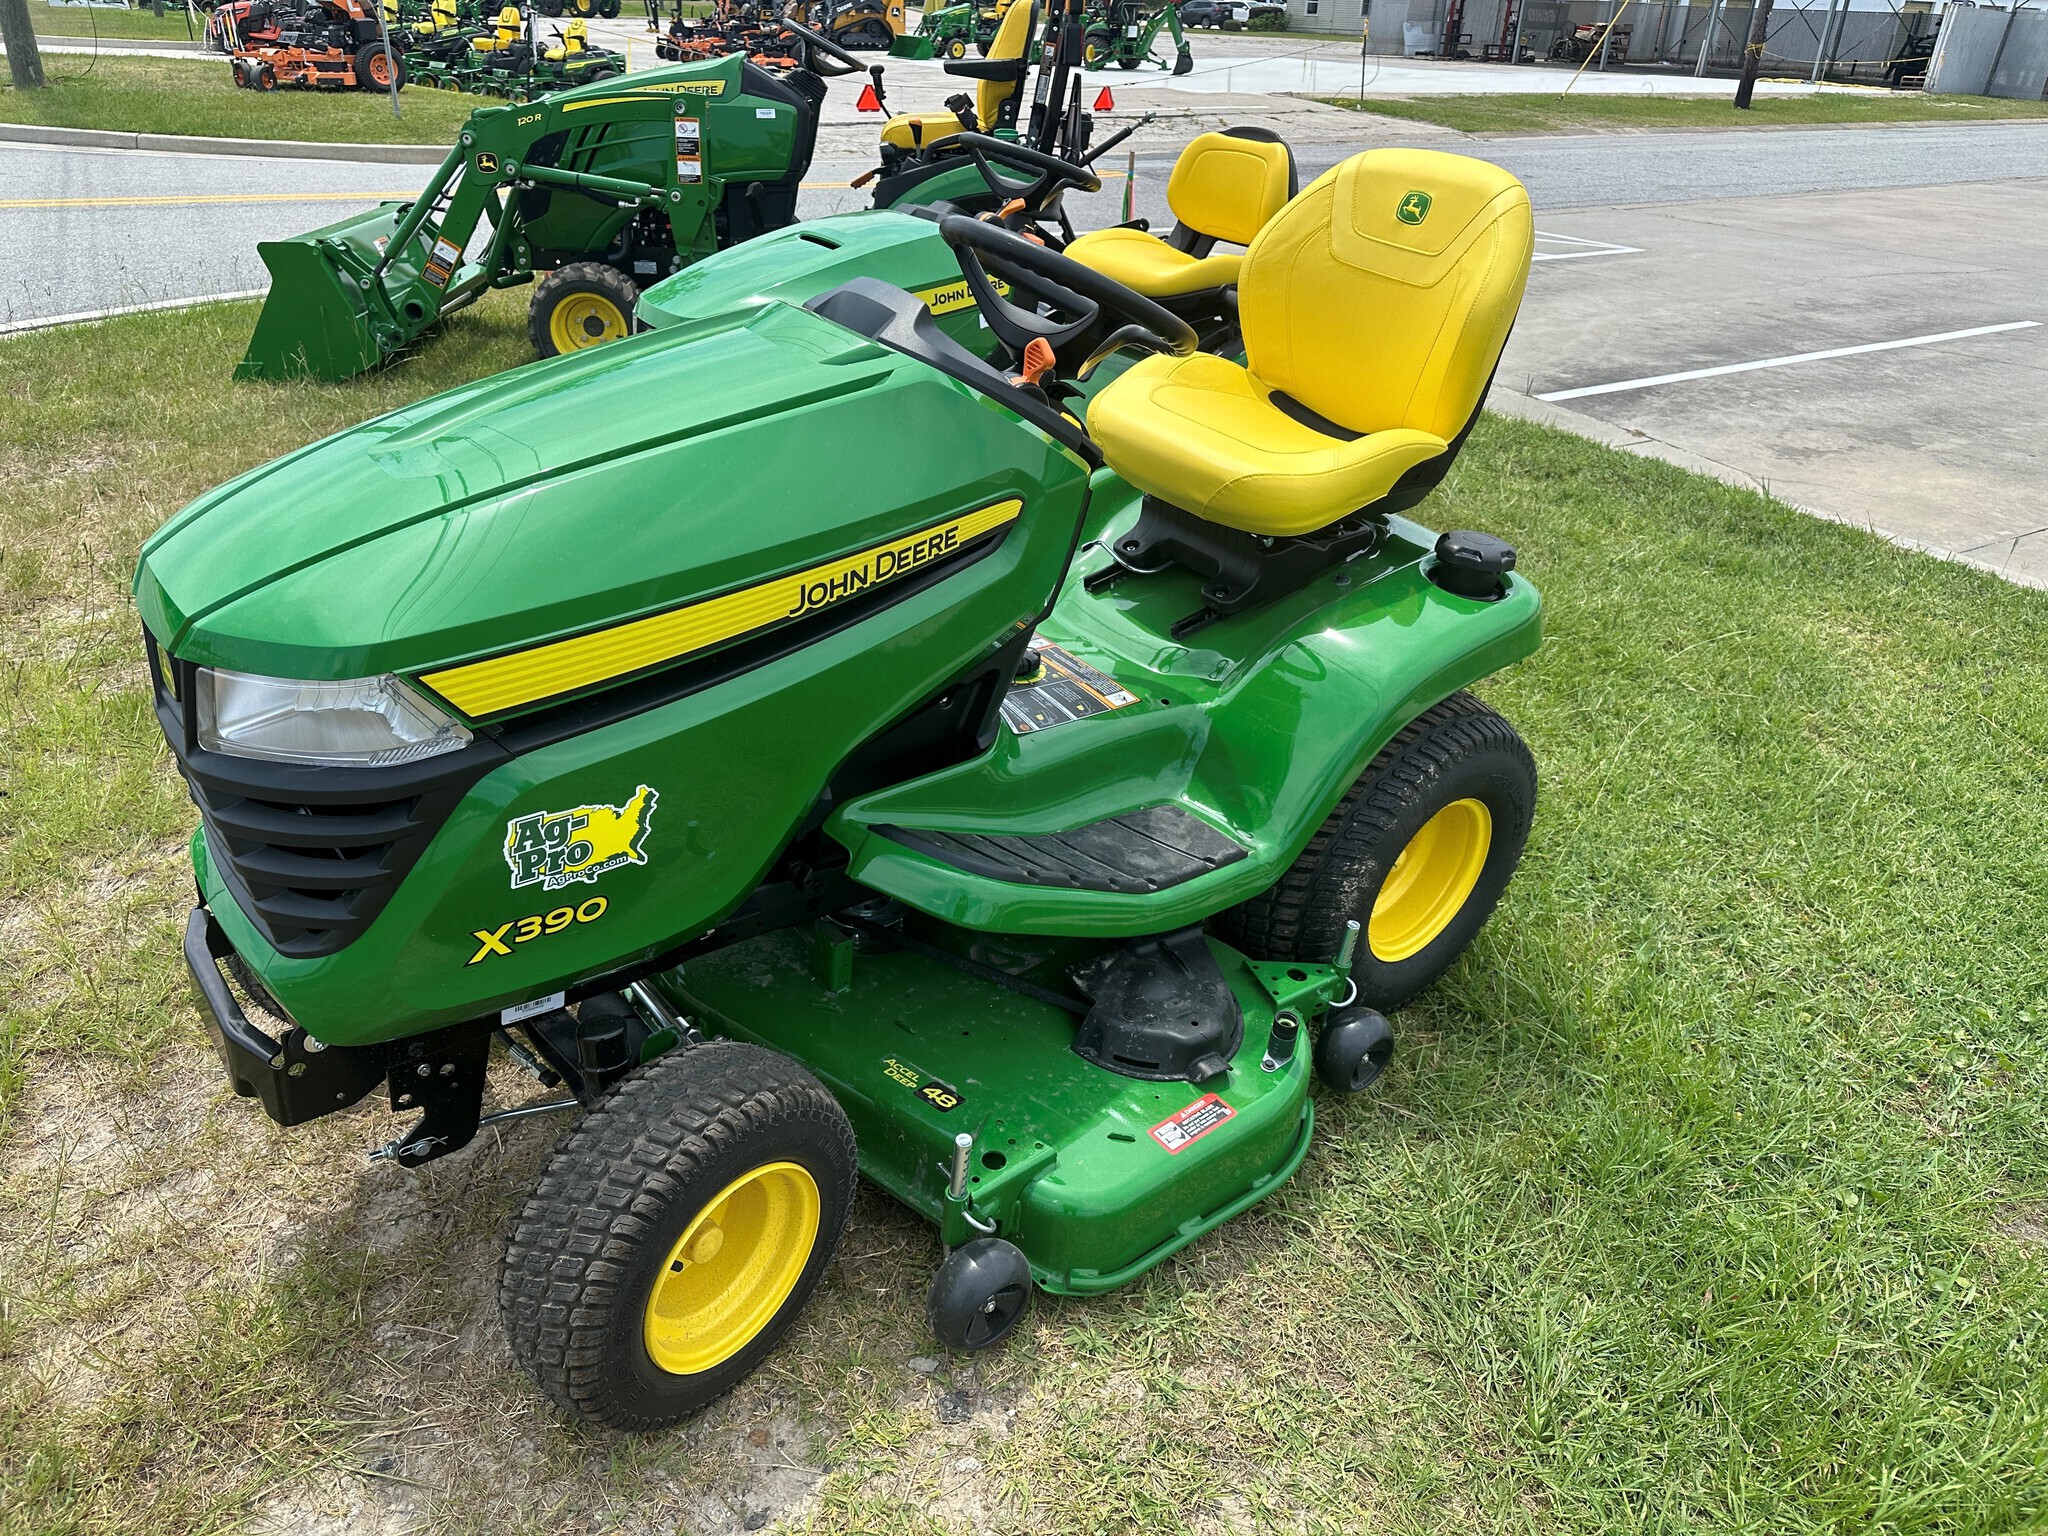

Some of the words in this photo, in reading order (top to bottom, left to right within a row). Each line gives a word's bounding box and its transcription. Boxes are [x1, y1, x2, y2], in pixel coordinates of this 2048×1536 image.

[931, 288, 965, 307] JOHN
[789, 564, 869, 616] JOHN
[875, 525, 960, 582] DEERE
[512, 813, 589, 854] Ag-
[517, 841, 593, 885] Pro
[547, 855, 629, 888] AgProCo.com
[463, 895, 609, 968] X390
[883, 1058, 920, 1082] ACCEL
[883, 1067, 918, 1088] DEEP
[922, 1087, 958, 1108] 48
